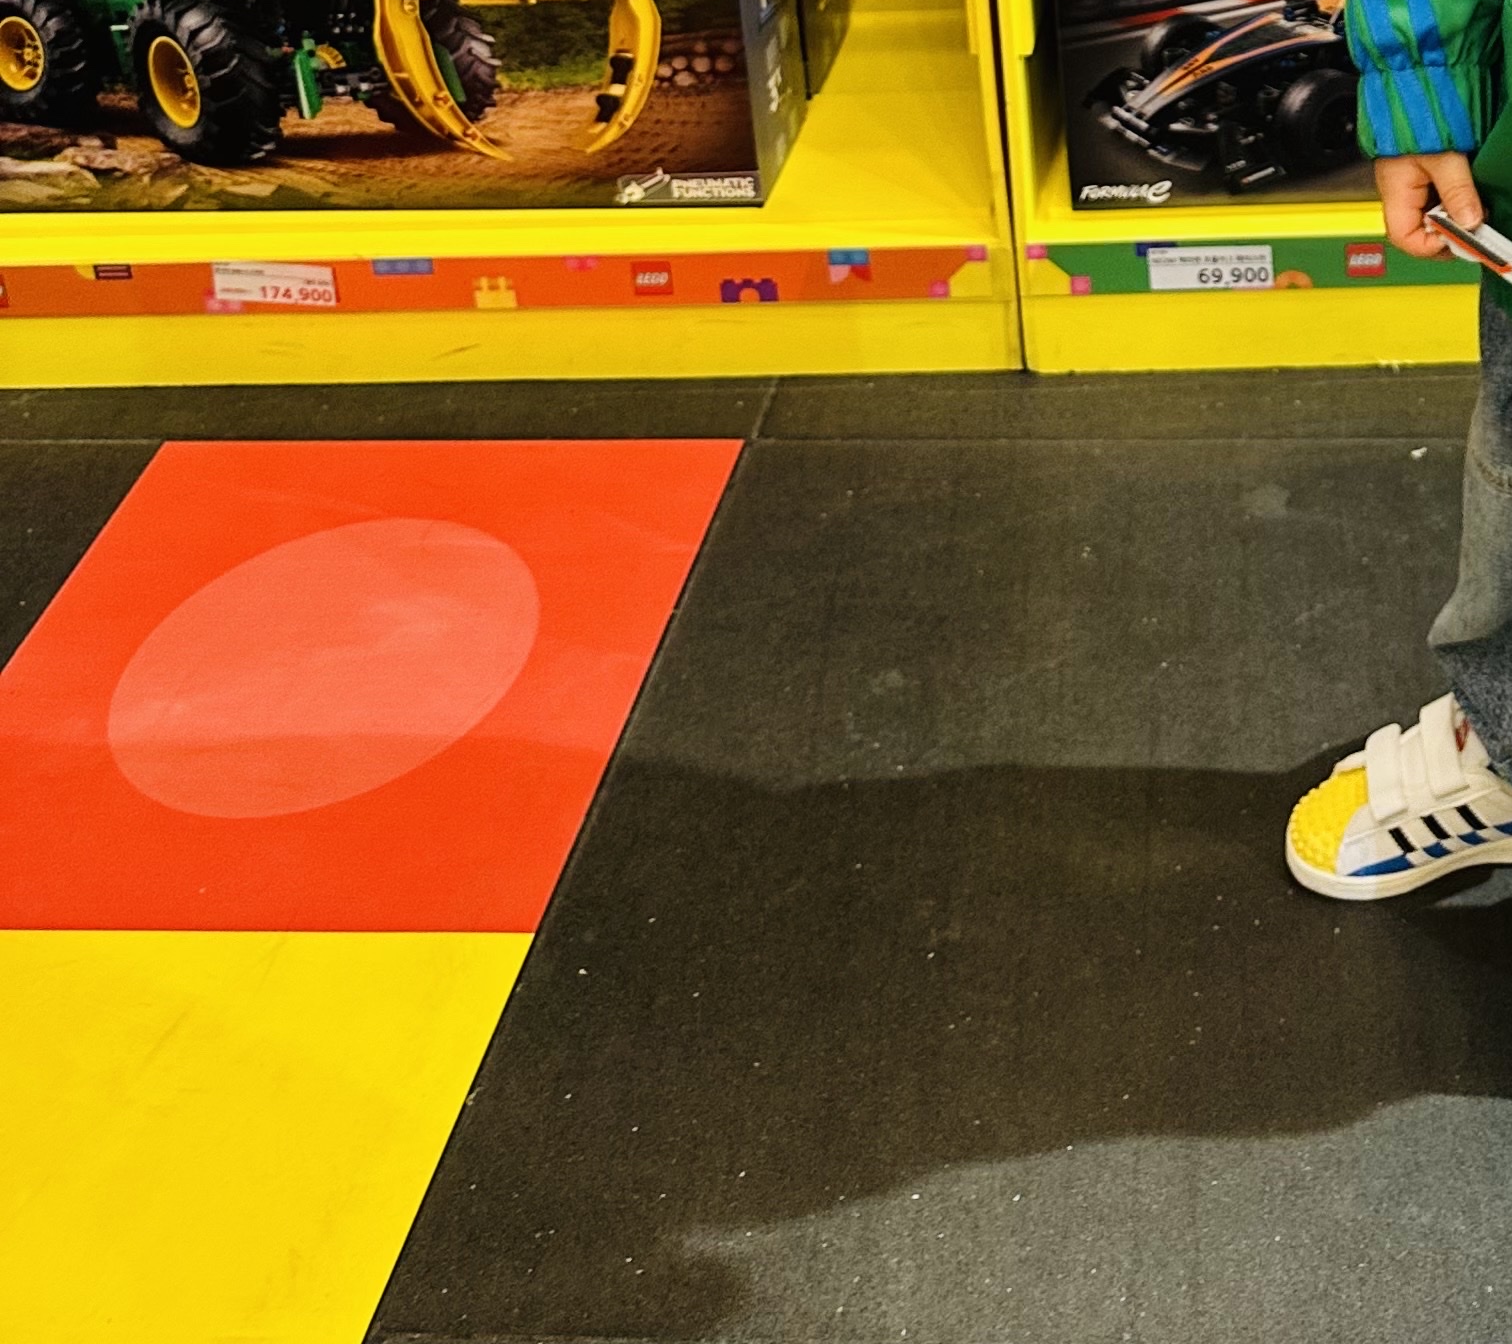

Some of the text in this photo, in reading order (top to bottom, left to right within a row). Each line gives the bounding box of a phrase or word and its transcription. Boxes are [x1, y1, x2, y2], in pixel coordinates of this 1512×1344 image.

[671, 176, 755, 189] PNEUMATIC
[671, 186, 757, 199] FUNCTIONS
[1349, 252, 1383, 267] LEGO
[635, 271, 669, 287] LEGO
[1198, 266, 1270, 287] 69,900
[260, 285, 333, 305] 174,900
